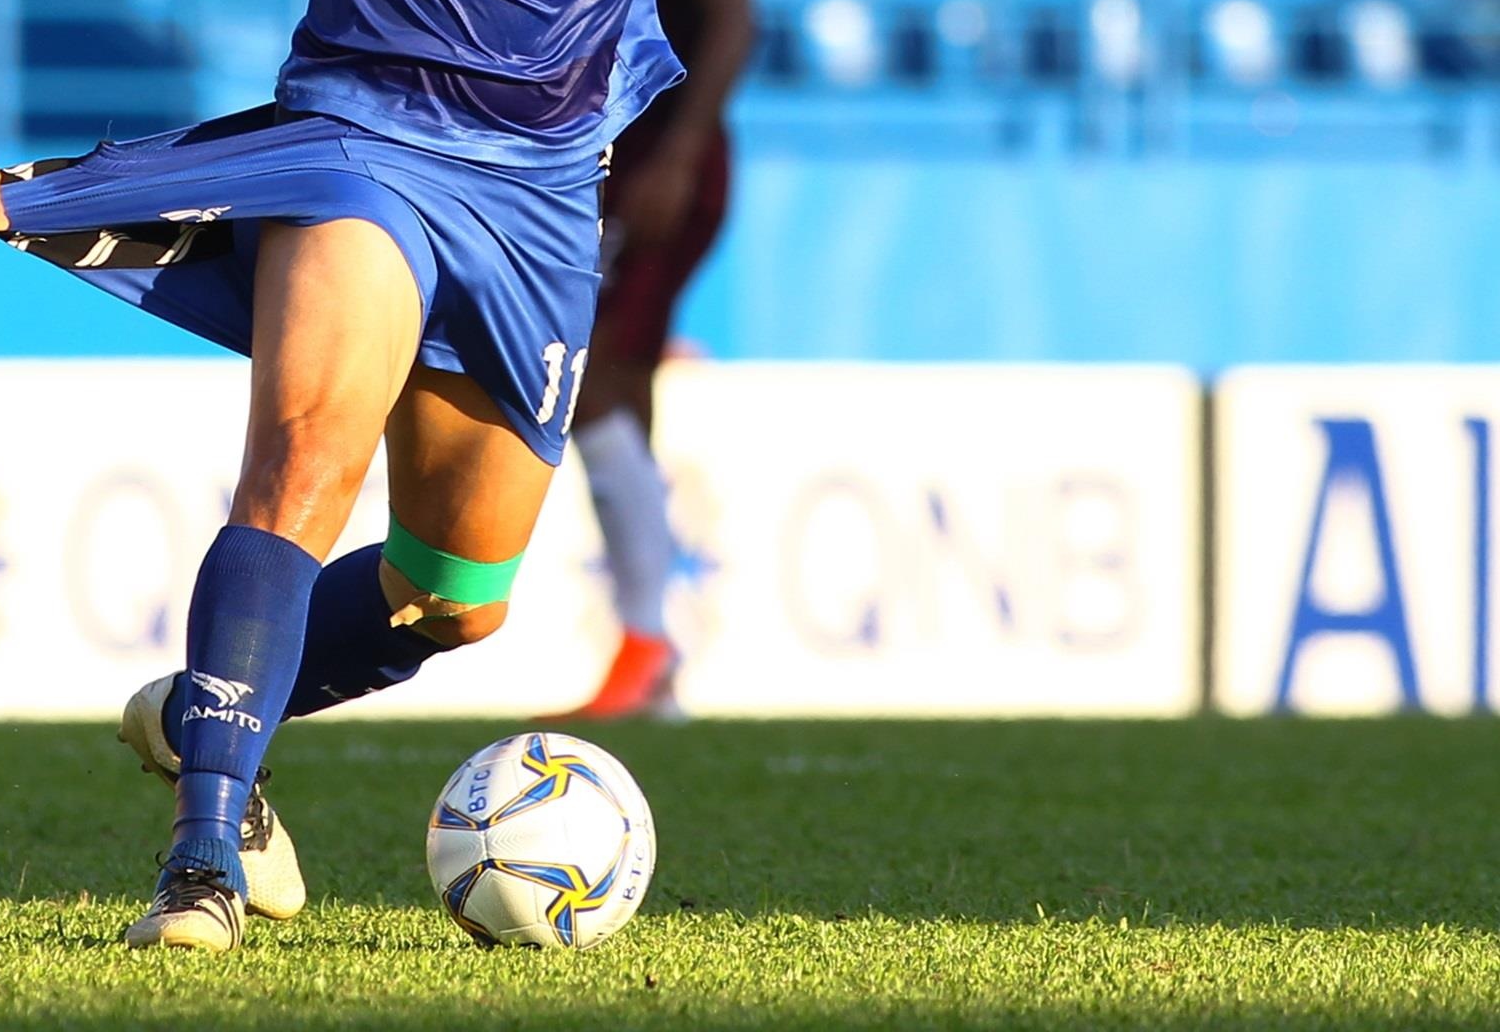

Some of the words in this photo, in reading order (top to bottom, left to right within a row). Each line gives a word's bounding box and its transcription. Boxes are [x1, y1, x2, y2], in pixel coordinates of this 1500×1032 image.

[536, 341, 588, 435] 11
[181, 705, 262, 734] KAMITO
[467, 768, 491, 814] BTC
